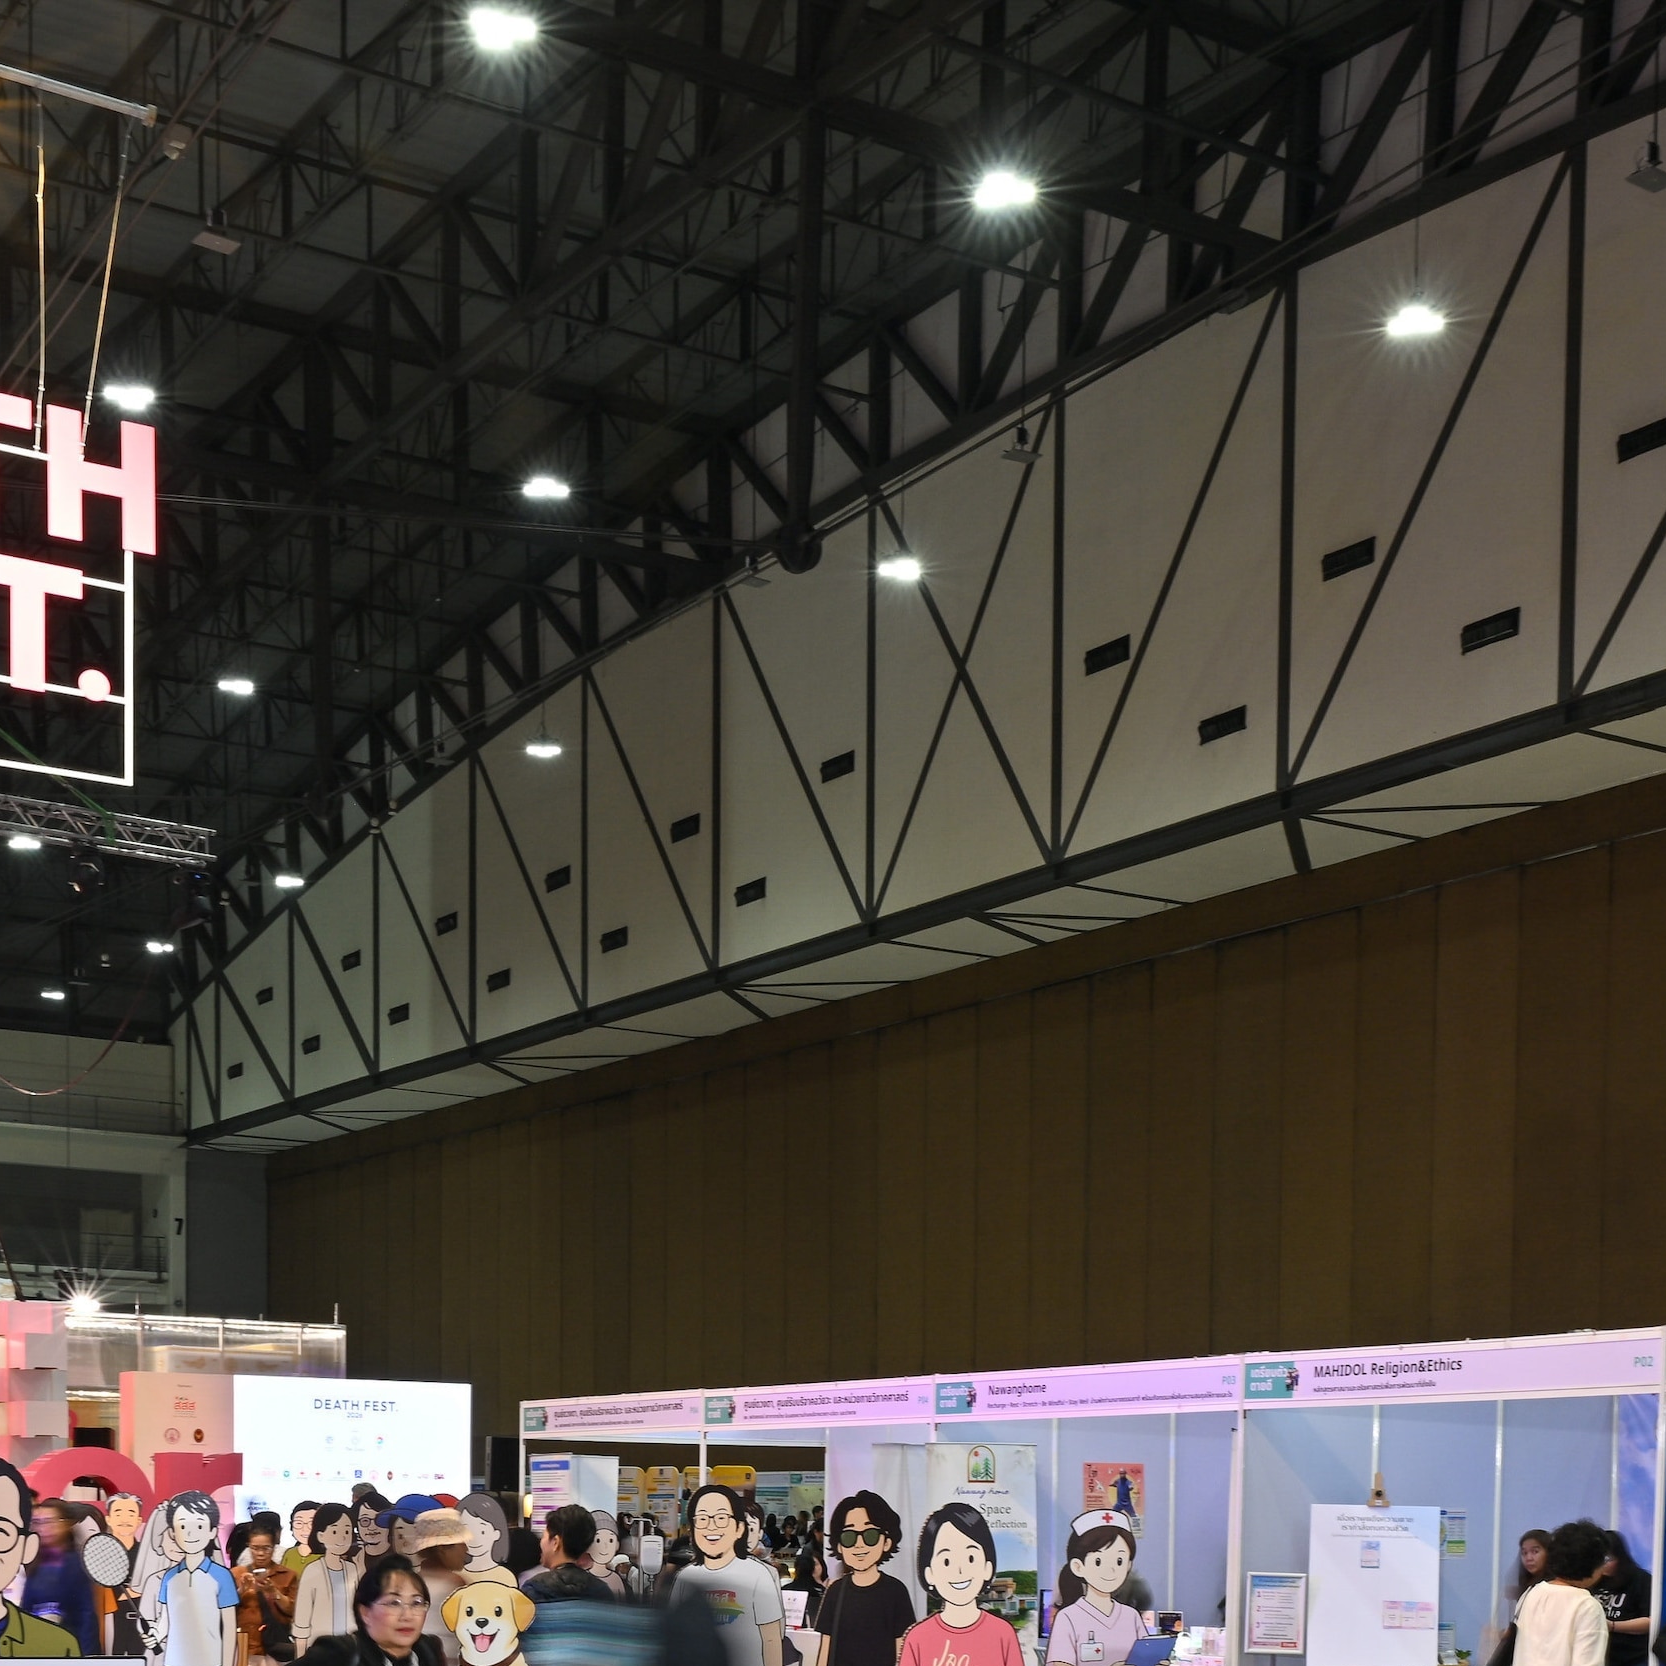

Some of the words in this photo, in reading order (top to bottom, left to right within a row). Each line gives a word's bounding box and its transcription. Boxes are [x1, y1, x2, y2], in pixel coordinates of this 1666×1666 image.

[1314, 1363, 1367, 1378] MAHIDOL
[1371, 1358, 1462, 1378] Religion&Ethics
[1634, 1355, 1654, 1368] P02
[988, 1383, 1047, 1397] Nawanghome
[314, 1398, 359, 1411] DEATH
[364, 1401, 398, 1412] FEST.
[979, 1503, 1011, 1517] Space
